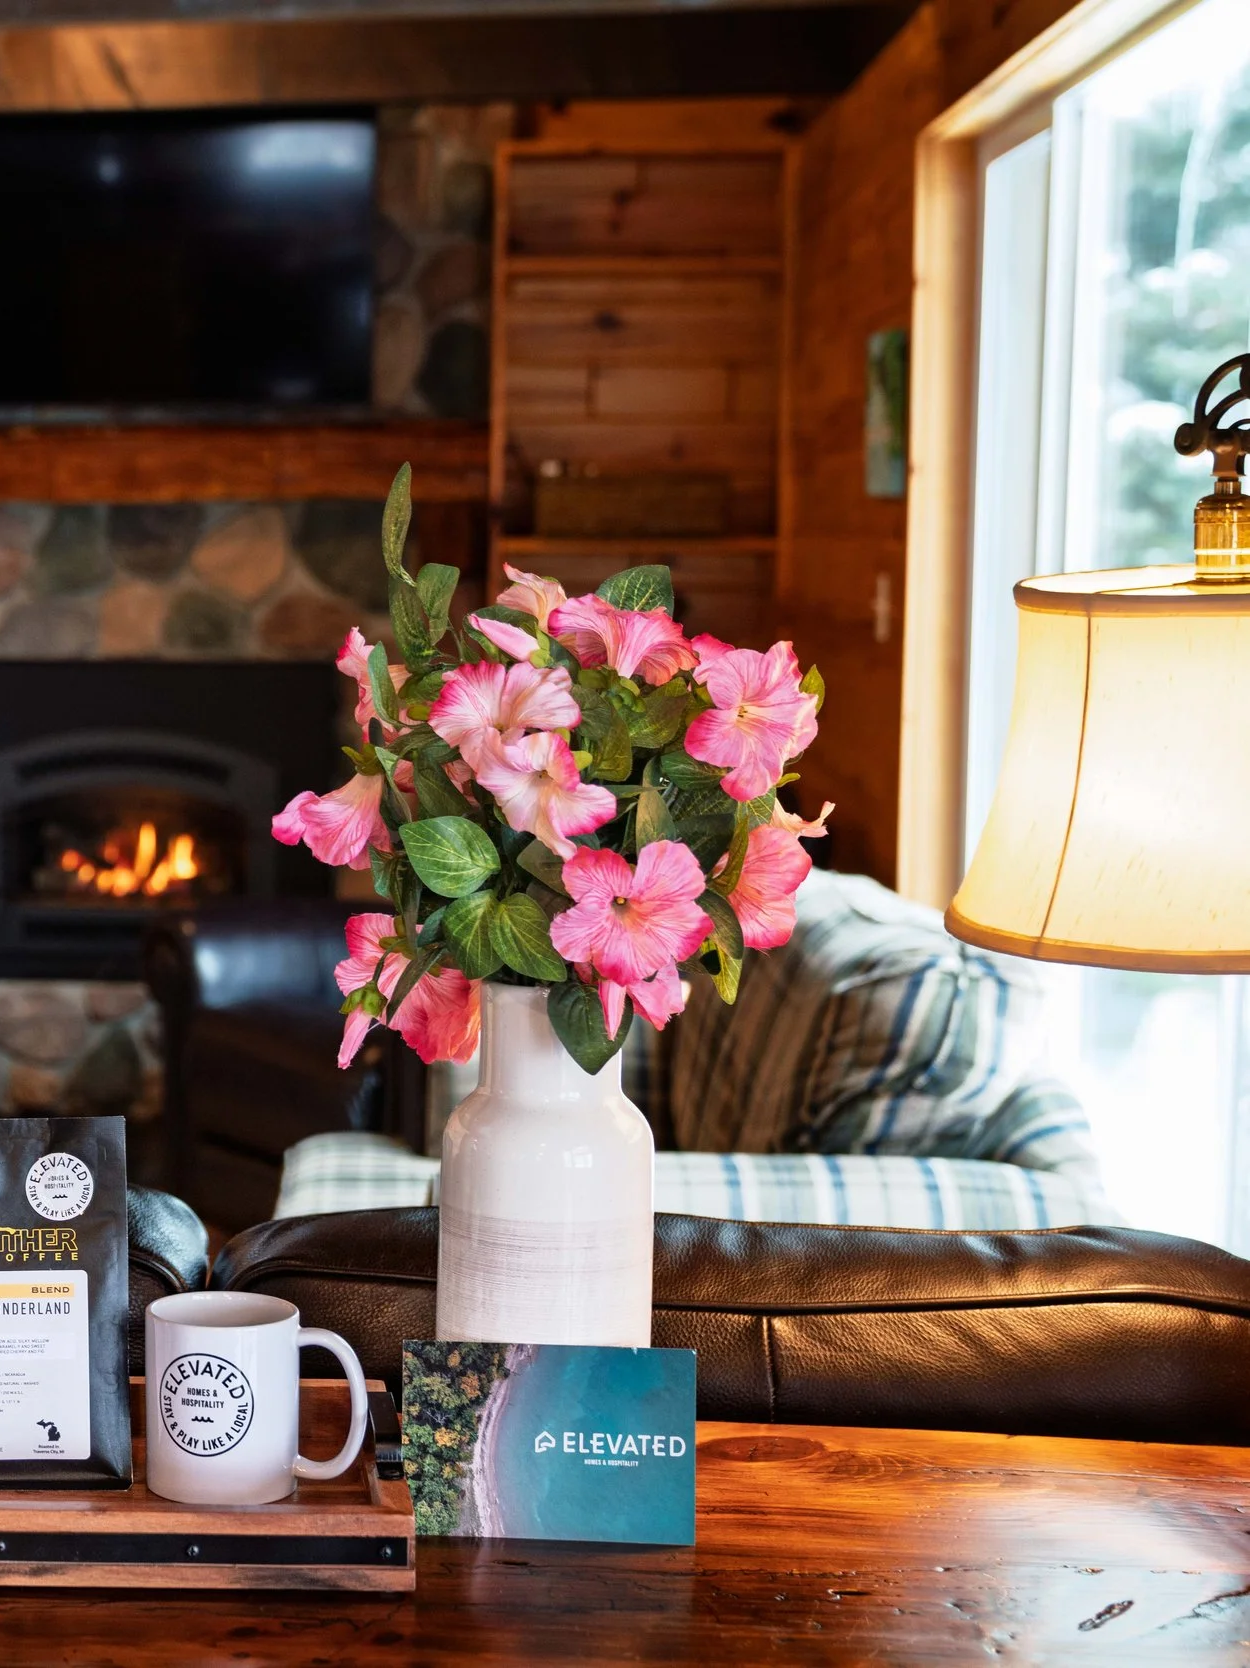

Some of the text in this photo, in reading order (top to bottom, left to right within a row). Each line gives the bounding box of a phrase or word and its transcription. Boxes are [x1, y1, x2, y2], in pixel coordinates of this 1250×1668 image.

[30, 1156, 88, 1184] ELEVATED
[29, 1185, 37, 1201] STAY
[42, 1207, 58, 1217] PLAY
[61, 1206, 76, 1217] LIKE
[79, 1183, 91, 1205] LOCAL
[165, 1360, 245, 1399] ELEVATED
[187, 1388, 210, 1397] HOMES
[181, 1398, 225, 1408] HOSPITALITY
[163, 1395, 248, 1450] STAY & PLAY LIKE A LOCAL
[563, 1431, 686, 1457] ELEVATED
